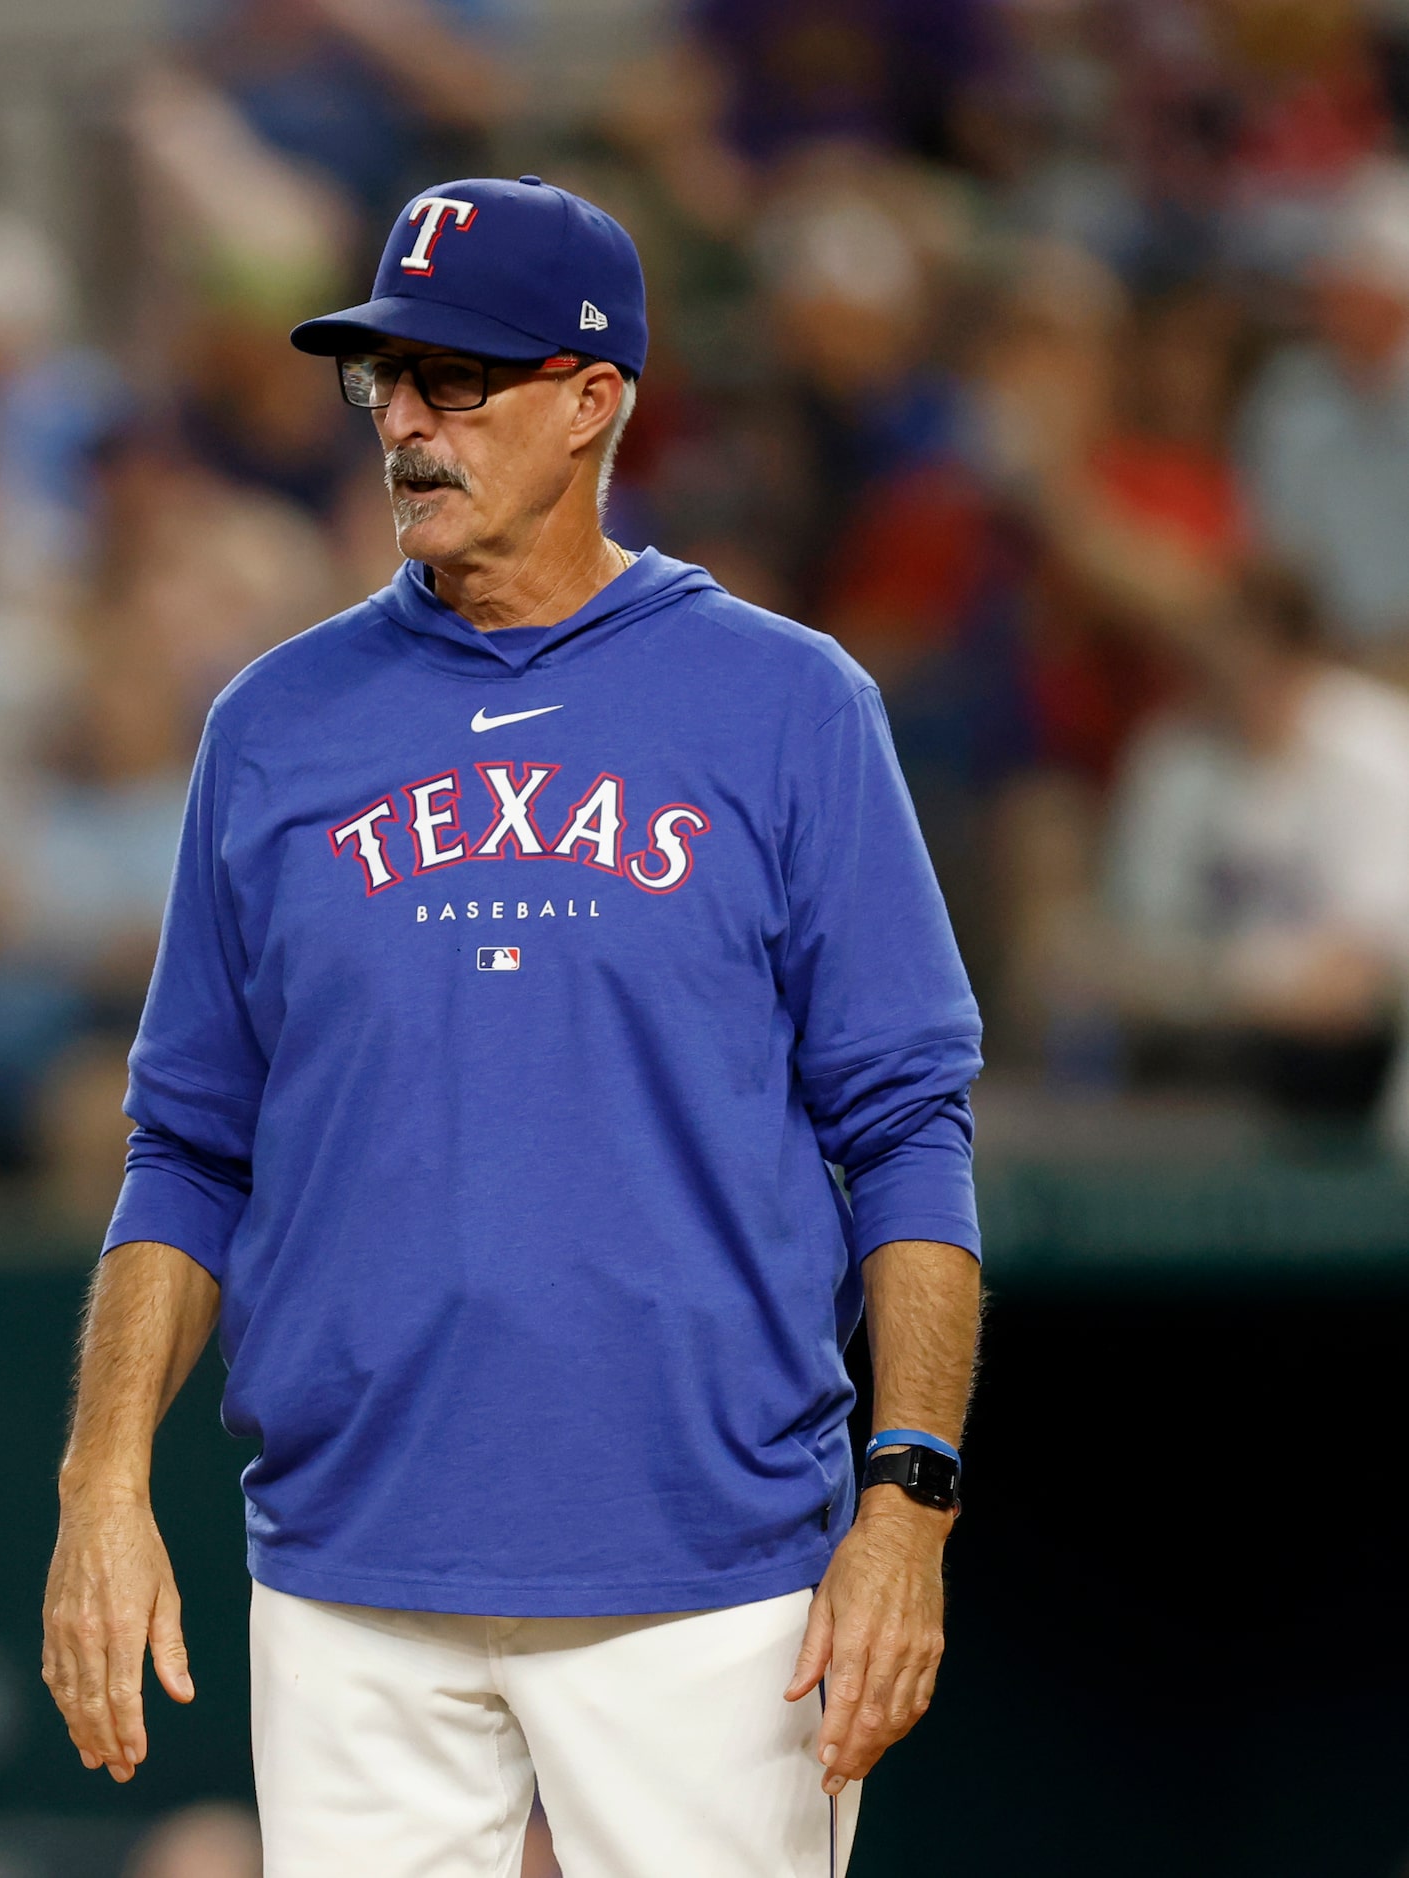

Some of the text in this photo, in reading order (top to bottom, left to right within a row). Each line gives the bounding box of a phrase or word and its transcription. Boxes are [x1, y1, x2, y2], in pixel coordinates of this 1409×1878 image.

[400, 197, 478, 277] T
[328, 761, 711, 897] TEXAS
[416, 899, 601, 923] BASEBALL
